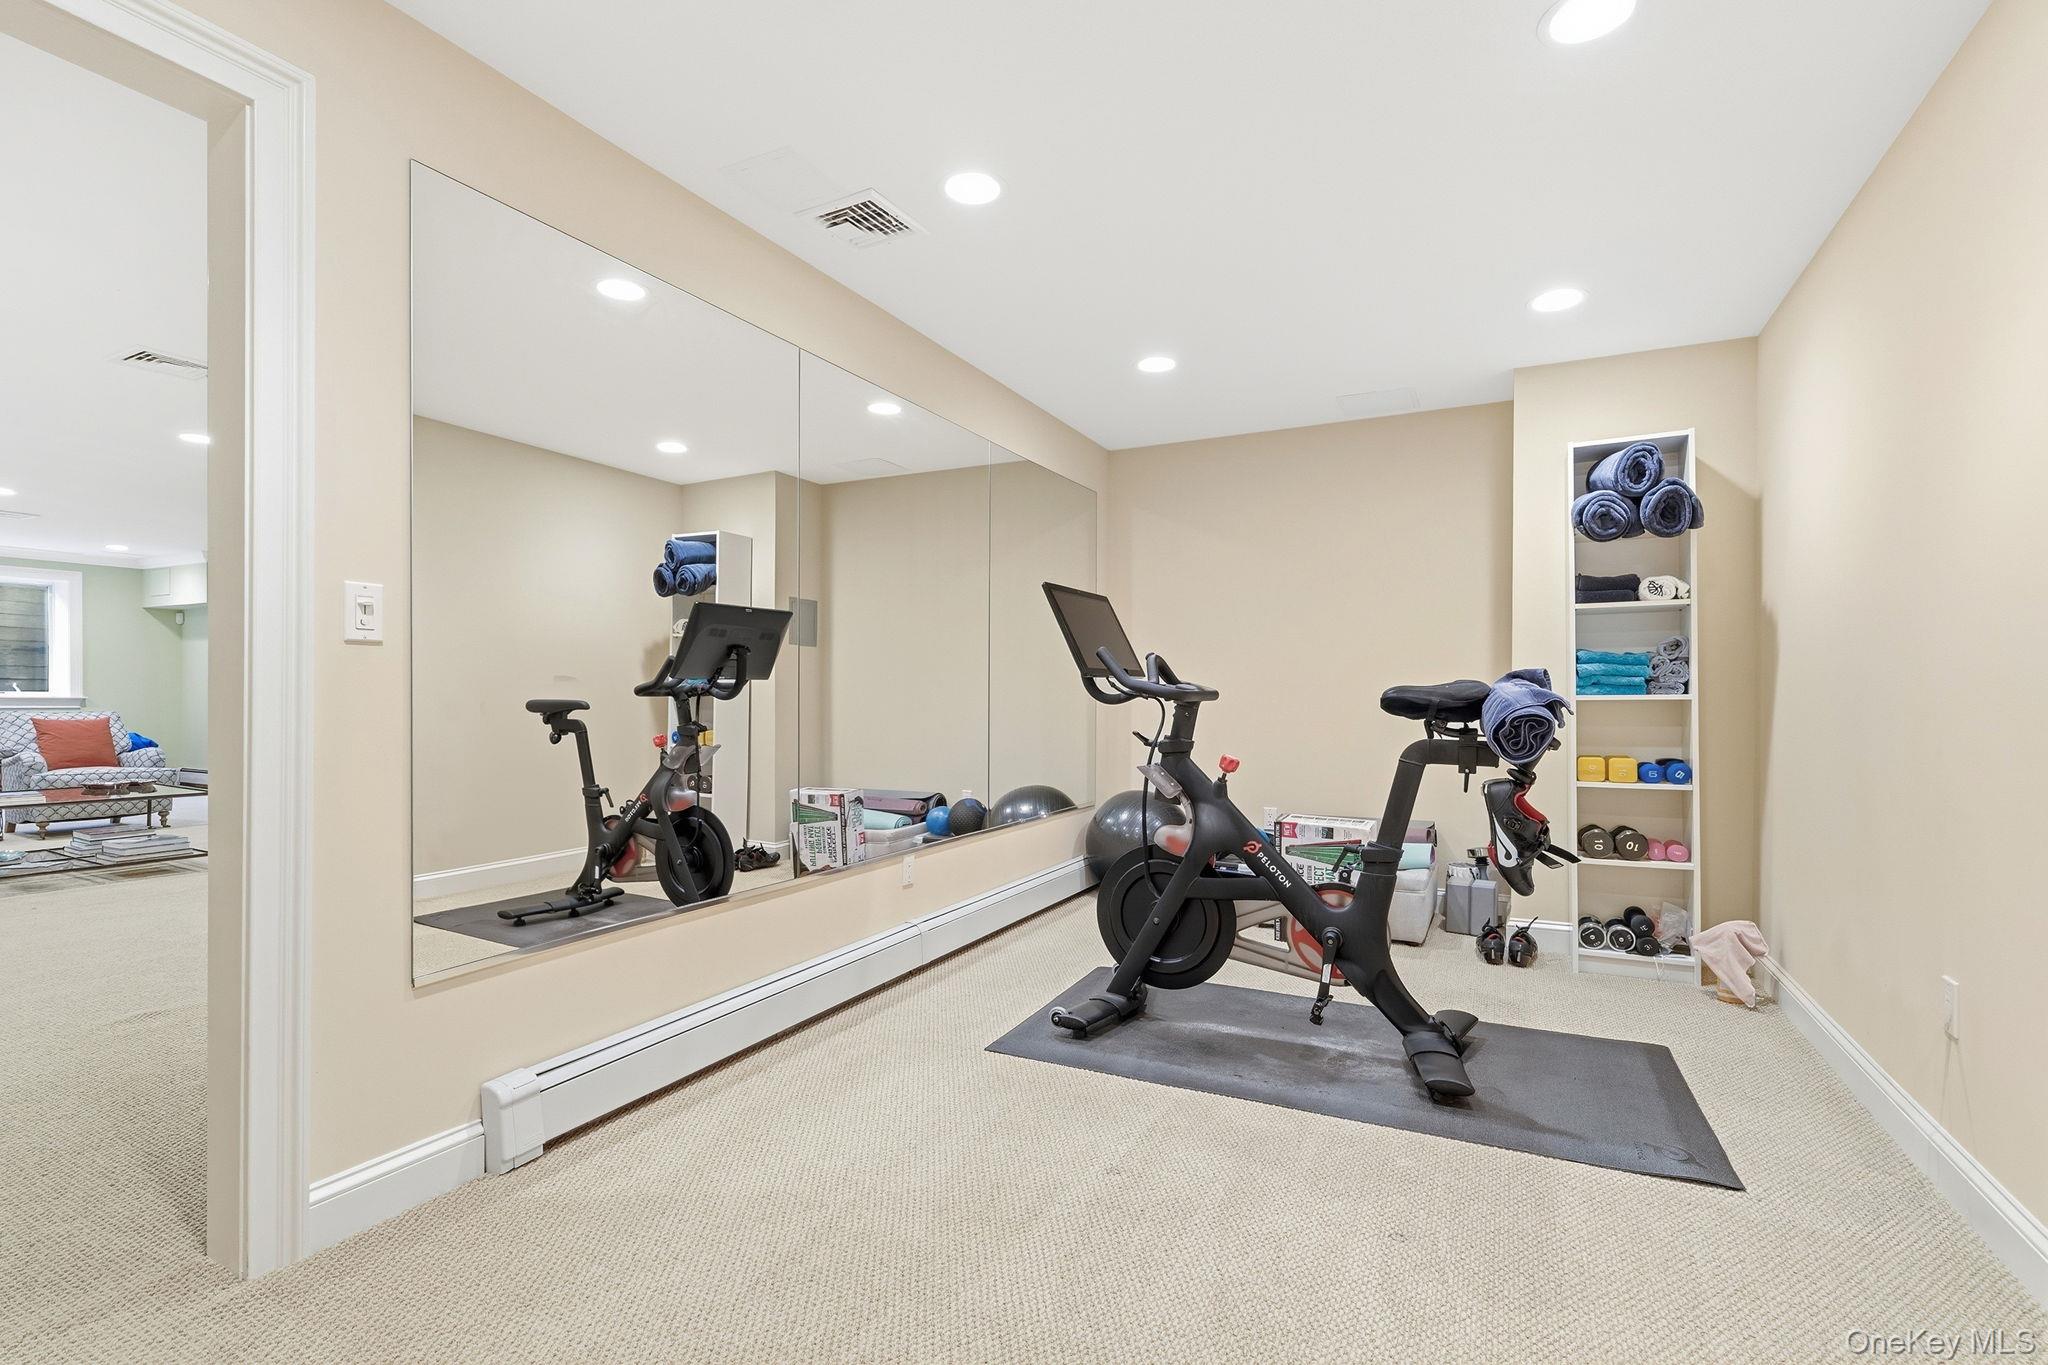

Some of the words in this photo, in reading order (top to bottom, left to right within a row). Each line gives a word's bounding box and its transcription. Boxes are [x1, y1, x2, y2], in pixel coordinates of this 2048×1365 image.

[1594, 839, 1604, 851] 10
[1626, 841, 1639, 852] 10
[1256, 852, 1292, 888] PELOTON
